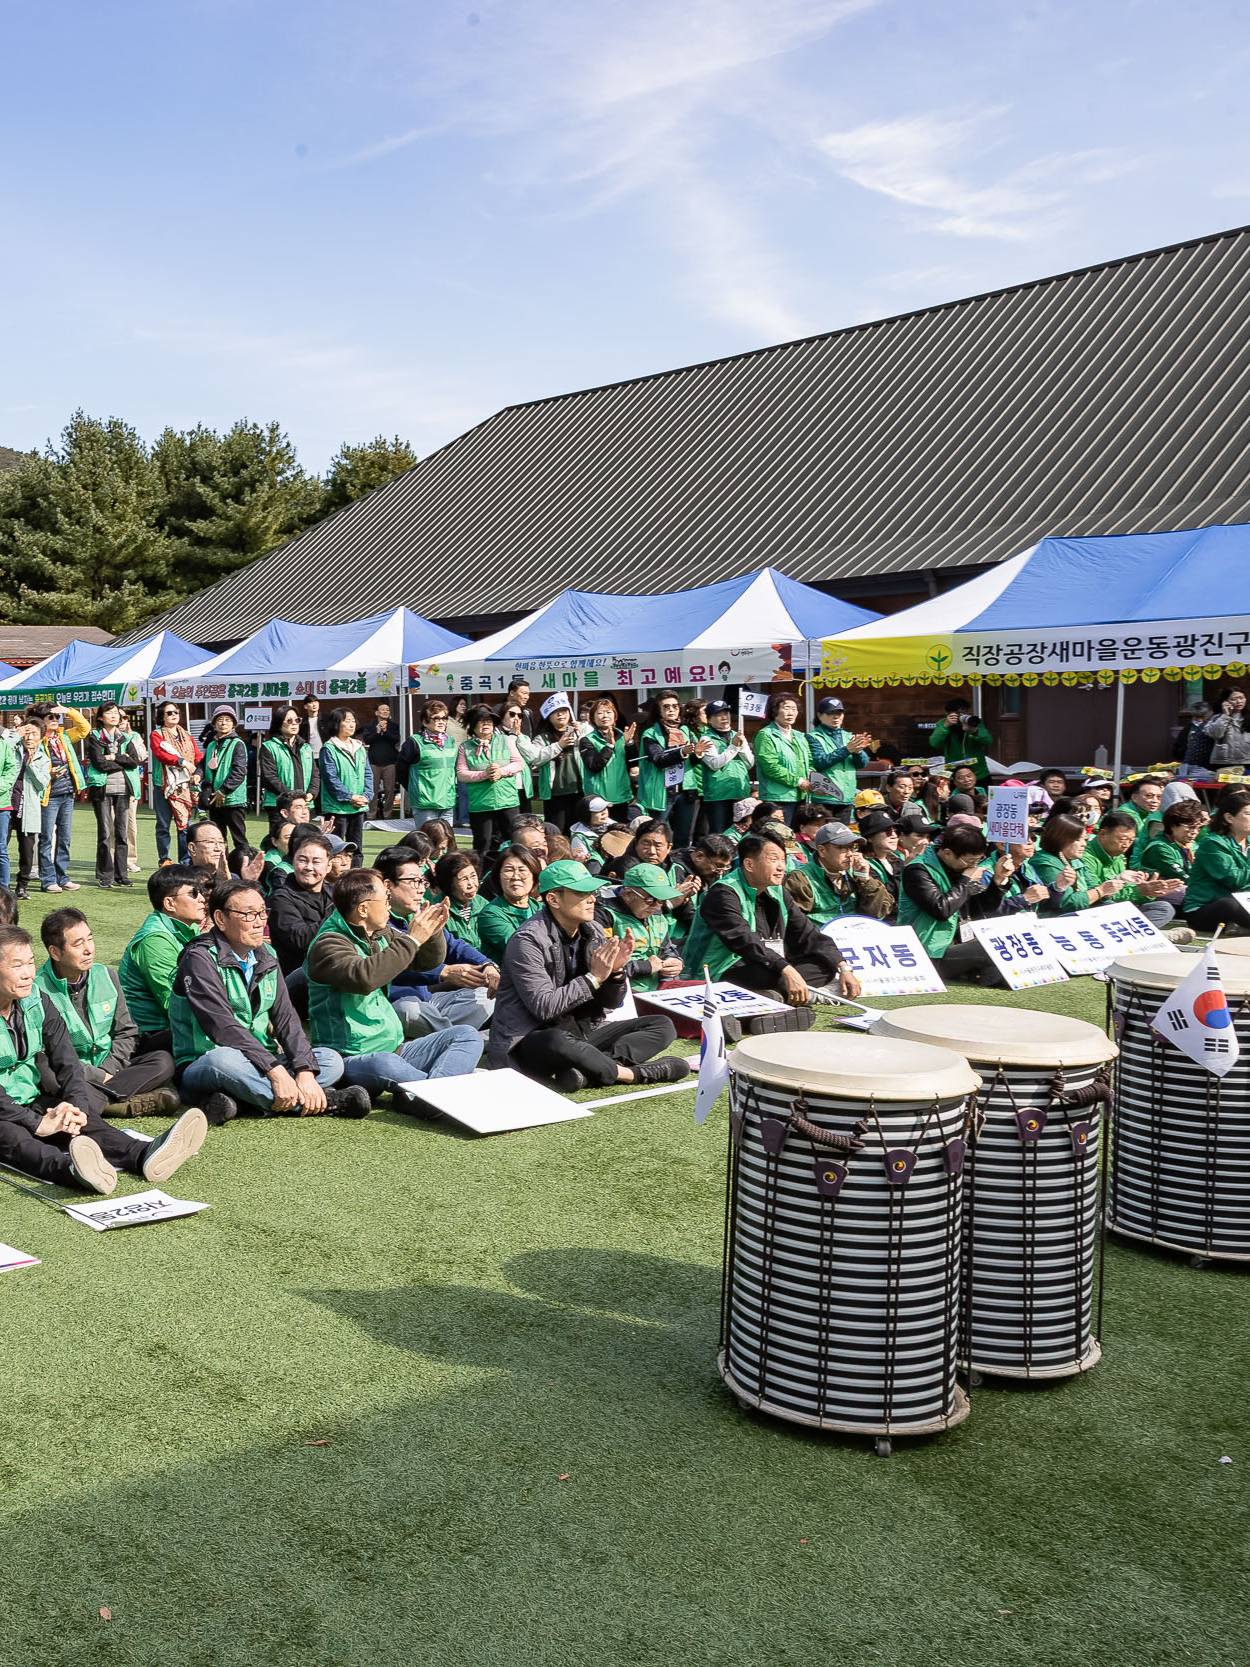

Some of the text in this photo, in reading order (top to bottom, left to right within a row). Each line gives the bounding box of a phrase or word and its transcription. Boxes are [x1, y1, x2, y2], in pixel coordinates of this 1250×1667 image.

[961, 632, 1250, 667] 직장공장새마을운동광진구
[170, 685, 194, 699] 오늘의
[195, 684, 227, 699] 주인공은
[227, 683, 260, 698] 중곡2동
[317, 680, 327, 695] 더
[328, 676, 367, 695] 중곡2동
[541, 670, 600, 689] 새마을
[617, 665, 715, 686] 최고예요!
[743, 702, 763, 713] 곡3동
[995, 803, 1018, 819] 광장동
[988, 821, 1025, 839] 새마을단체
[989, 931, 1044, 962] 광장동
[89, 1199, 173, 1222] 자양2동
